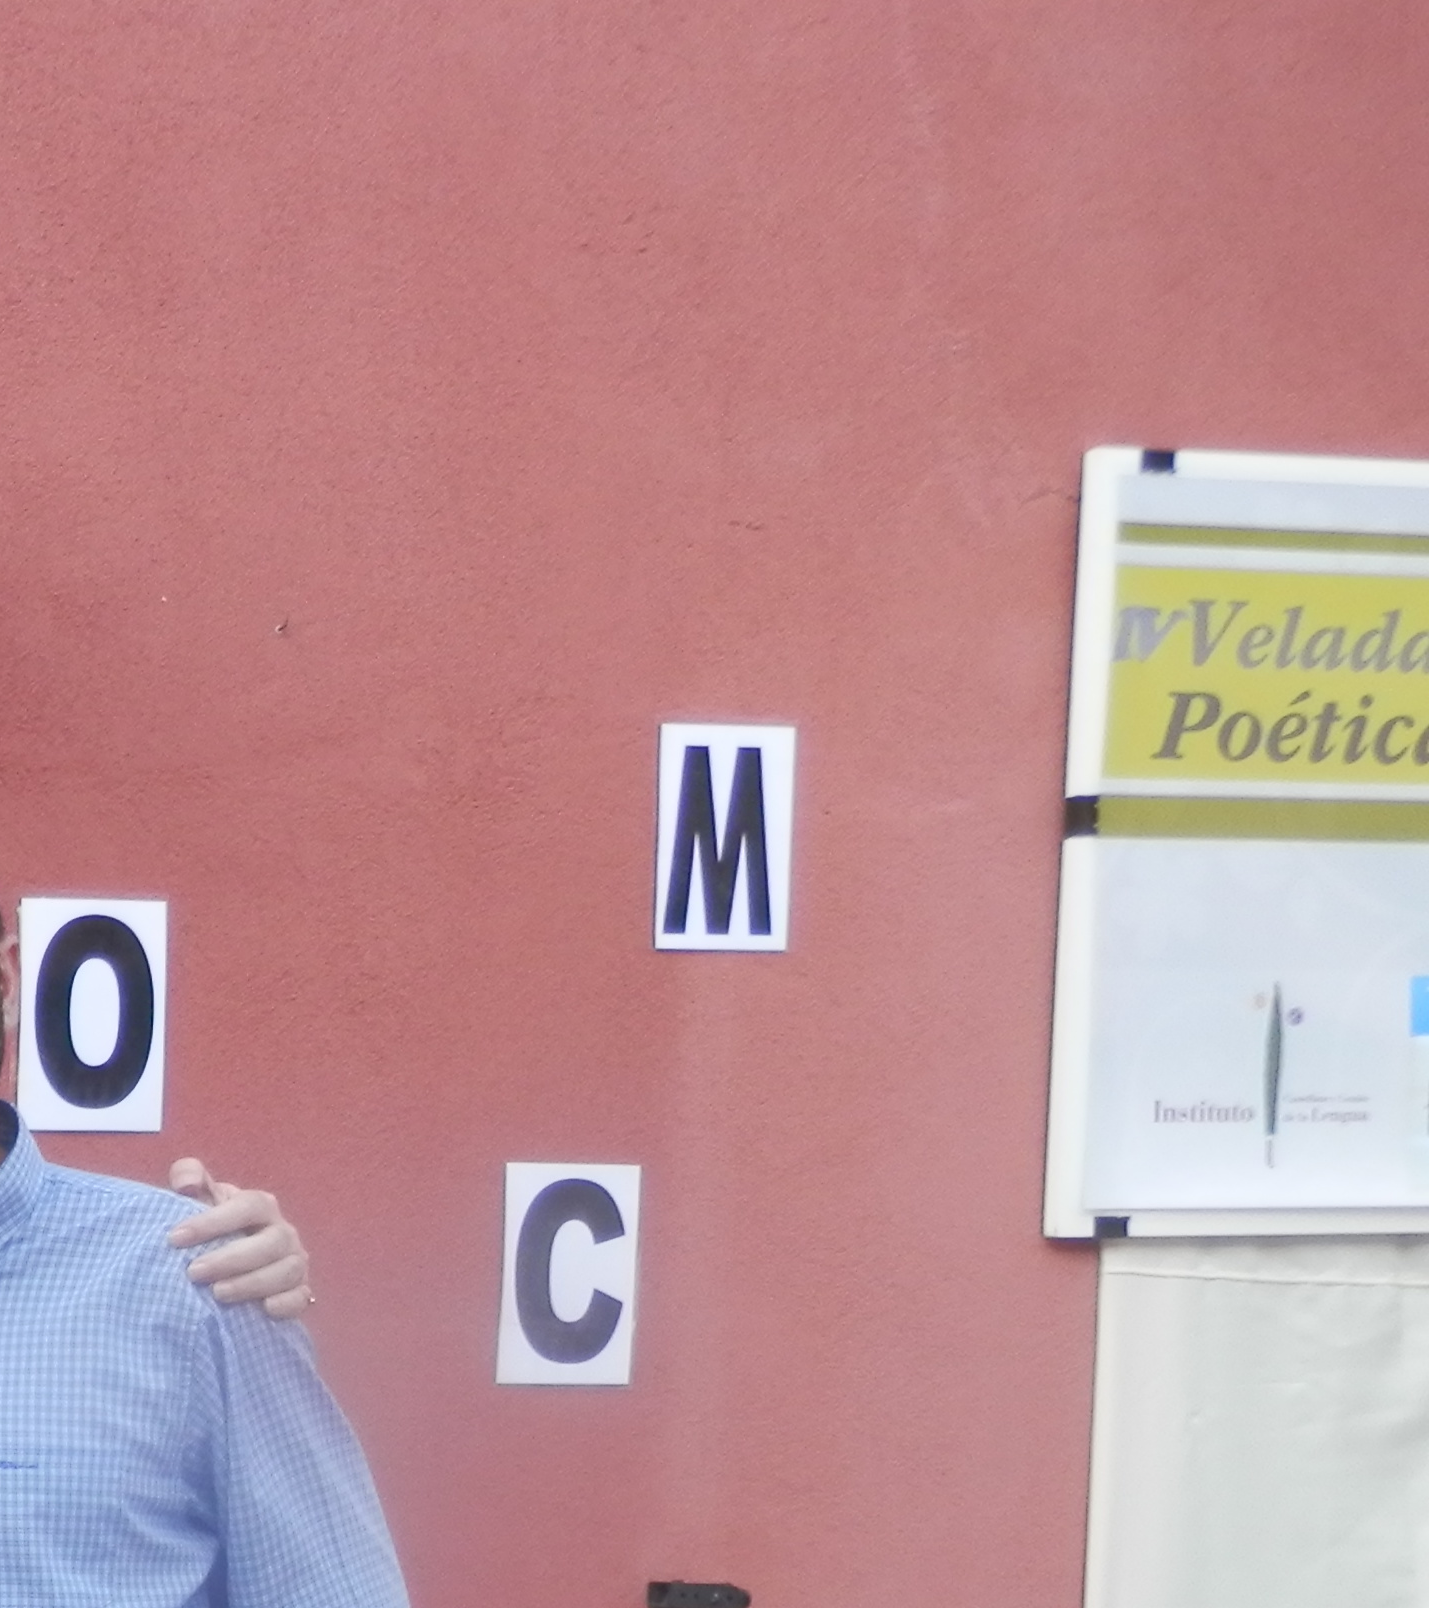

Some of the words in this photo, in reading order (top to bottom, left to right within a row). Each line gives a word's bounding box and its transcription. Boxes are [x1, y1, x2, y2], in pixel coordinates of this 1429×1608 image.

[662, 744, 773, 936] M
[34, 913, 155, 1109] O
[1153, 1099, 1256, 1124] Instituto
[515, 1177, 626, 1364] C
